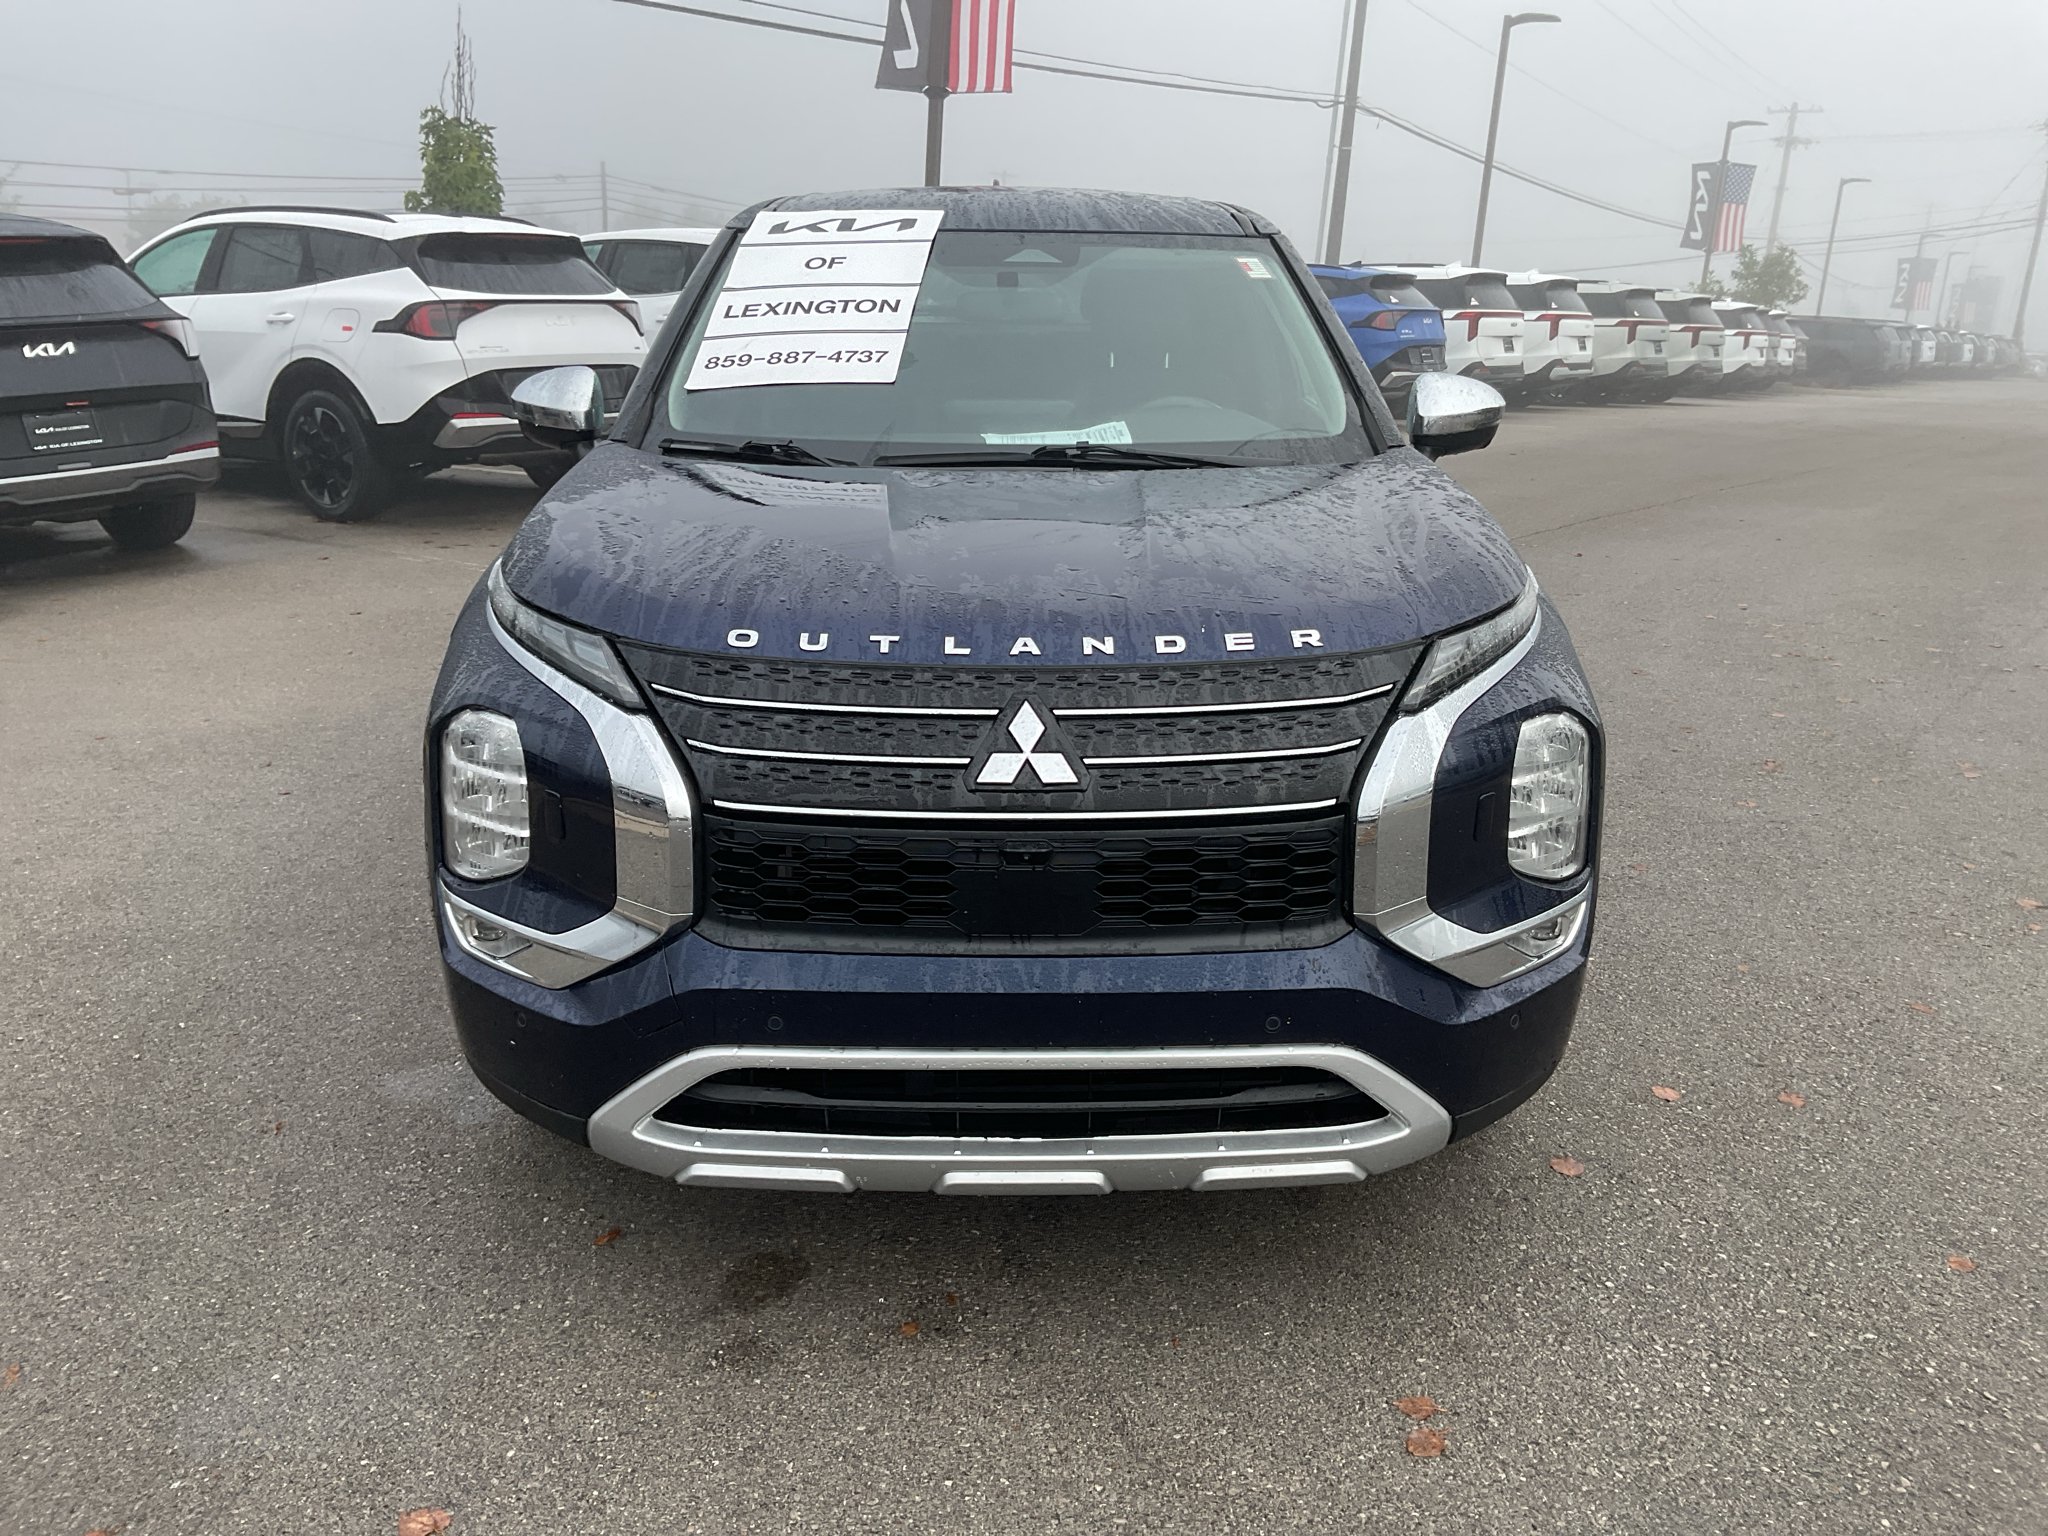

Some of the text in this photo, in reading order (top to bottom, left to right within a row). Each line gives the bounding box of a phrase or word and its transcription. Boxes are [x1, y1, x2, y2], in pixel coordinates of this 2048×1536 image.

[768, 218, 918, 234] KIA
[804, 256, 847, 270] OF
[723, 299, 901, 319] LEXINGTON
[22, 341, 76, 358] KIA
[704, 350, 889, 370] 859-887-4737
[726, 628, 1325, 656] OUTLANDER
